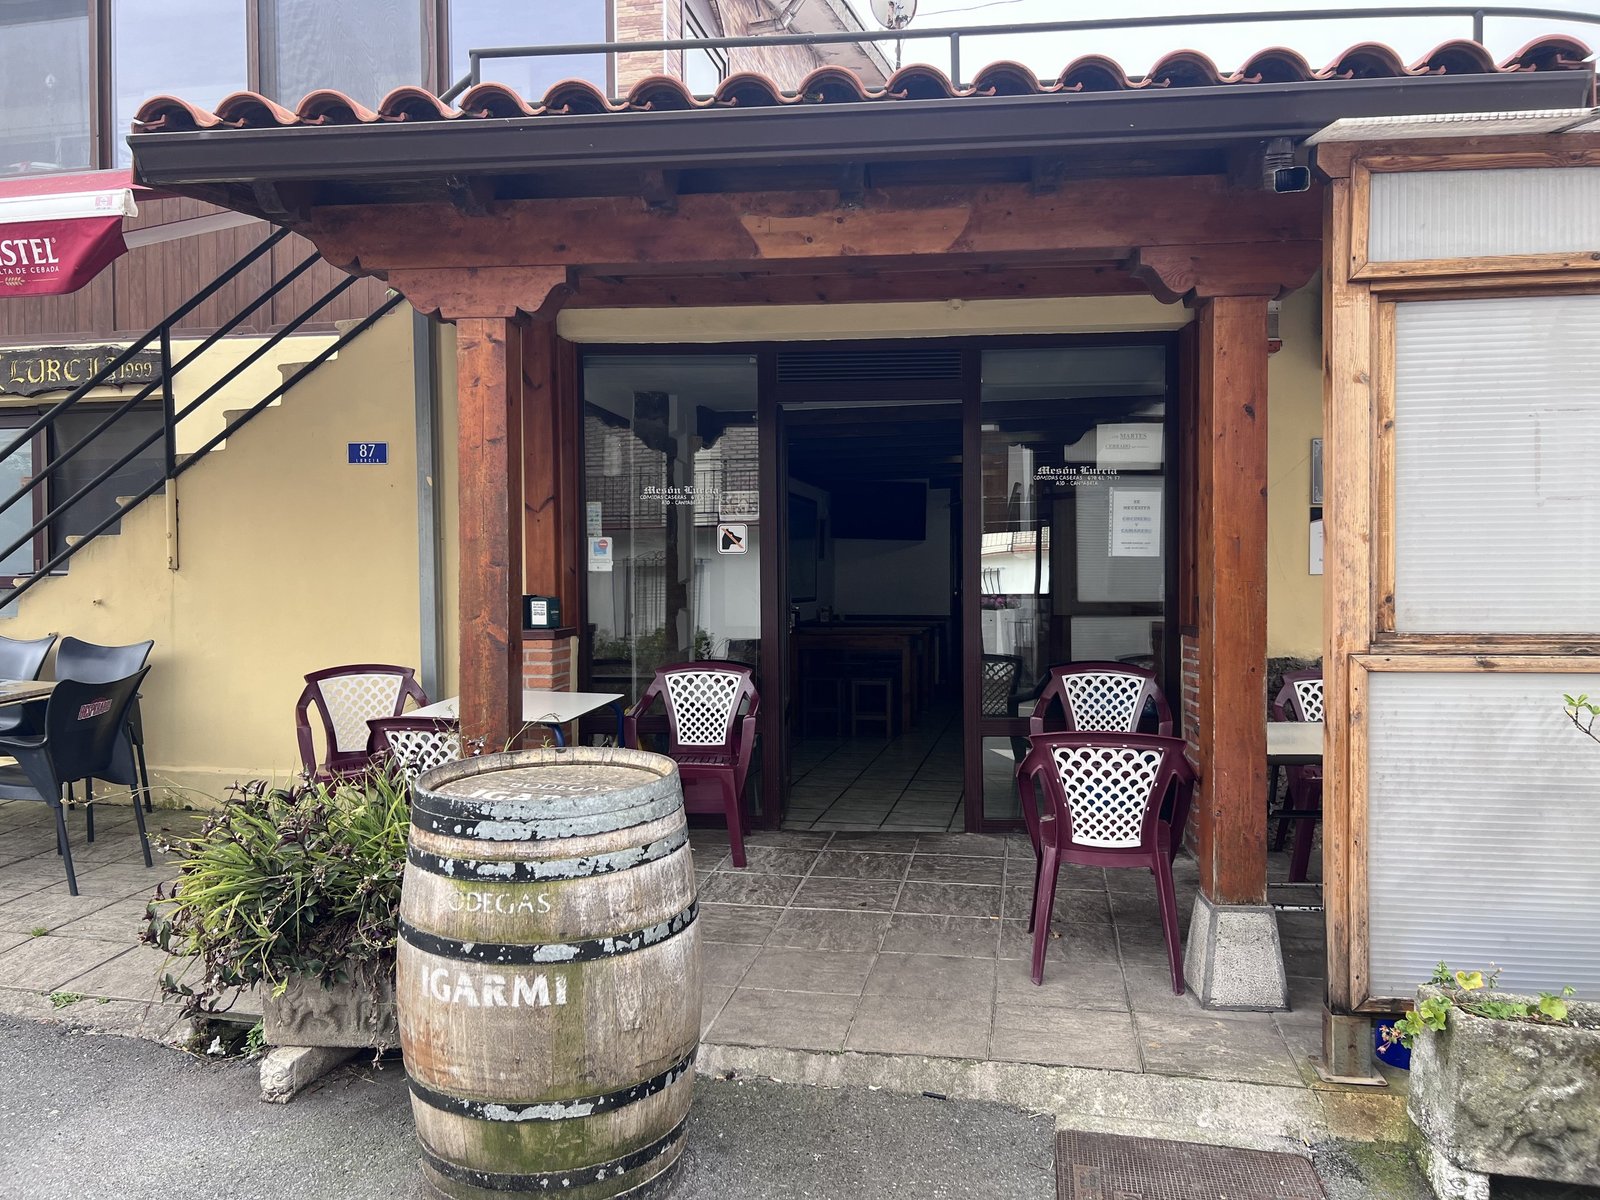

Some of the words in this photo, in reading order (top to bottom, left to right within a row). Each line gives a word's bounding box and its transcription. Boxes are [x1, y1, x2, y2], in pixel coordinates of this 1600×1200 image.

[0, 237, 59, 266] STEL
[30, 265, 60, 274] CEBADA
[360, 444, 375, 457] 87
[1037, 466, 1076, 475] Mesón
[643, 486, 681, 494] Mesón
[442, 891, 551, 914] ODEGAS
[420, 964, 568, 1008] IGARMI
